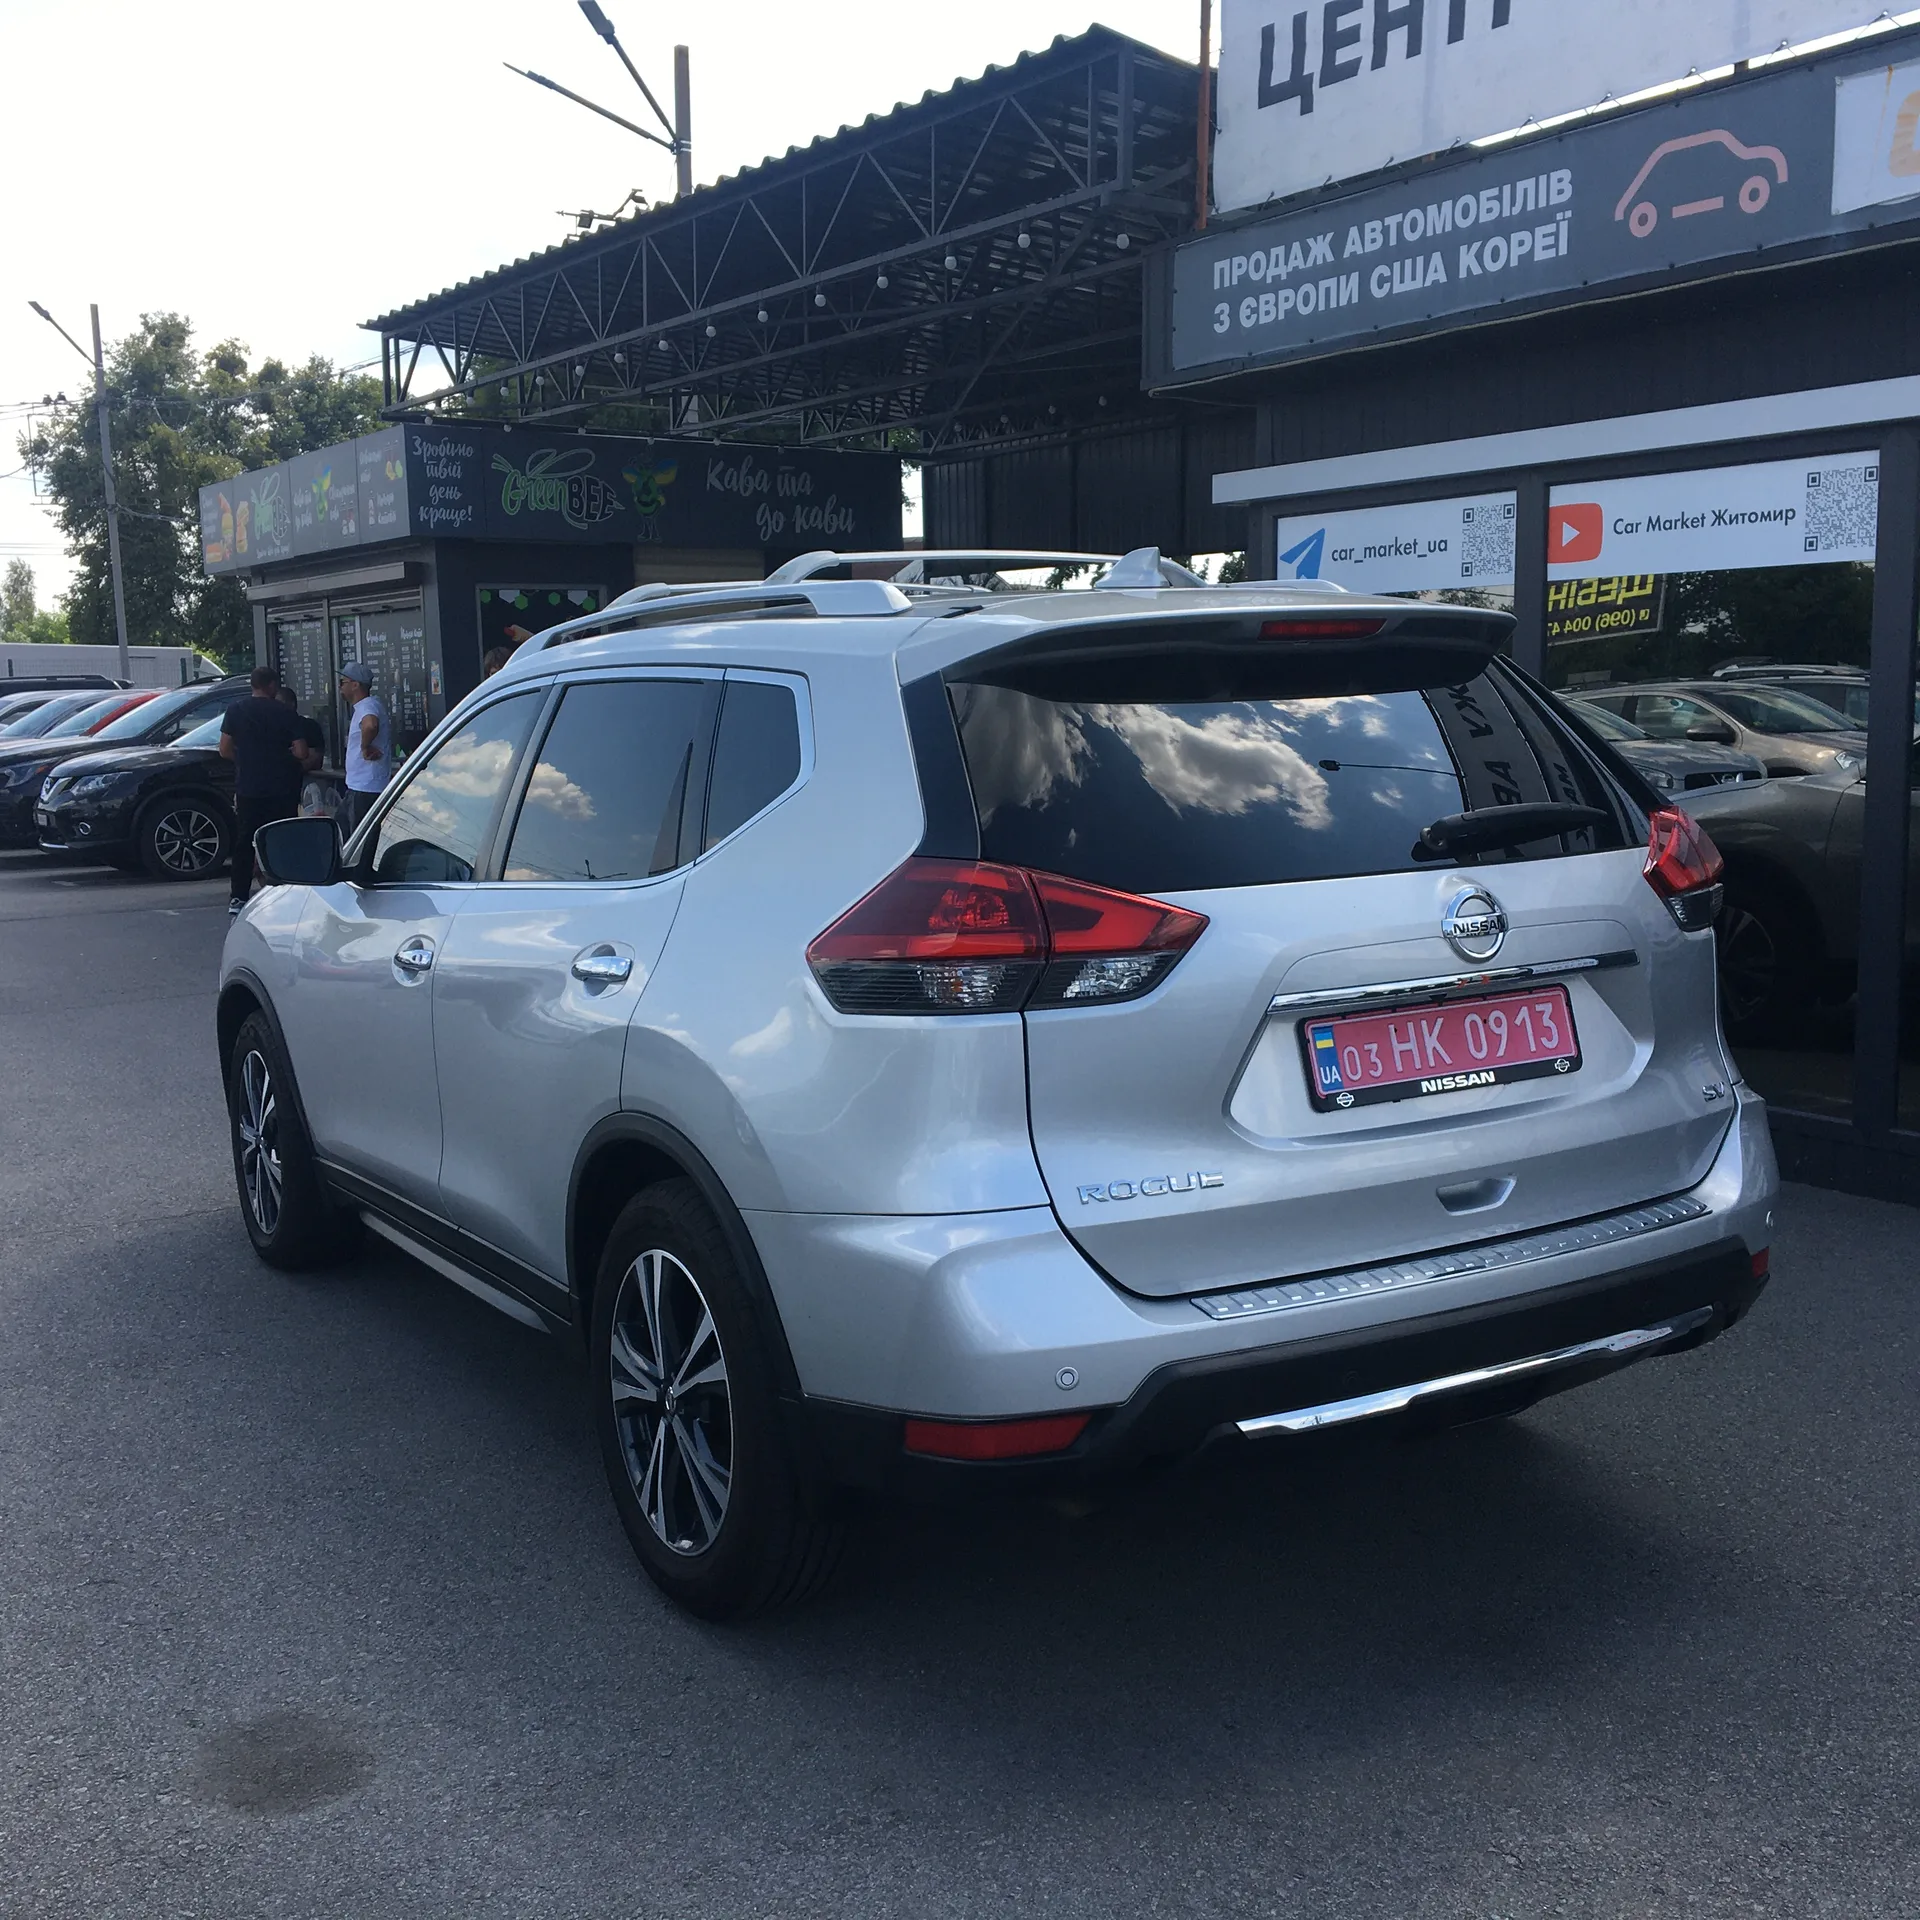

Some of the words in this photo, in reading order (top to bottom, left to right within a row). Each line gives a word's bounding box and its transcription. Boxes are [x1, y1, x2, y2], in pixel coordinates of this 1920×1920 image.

[1213, 231, 1335, 291] ПРОДАЖ
[1343, 168, 1574, 259] АВТОМОБІЛІВ
[1213, 301, 1231, 334] З
[1239, 271, 1360, 329] ЄВРОПИ
[1370, 250, 1448, 299] США
[1459, 210, 1573, 280] КОРЕЇ
[429, 484, 462, 505] день
[418, 505, 473, 529] краще!
[1613, 518, 1642, 536] Car
[1646, 512, 1707, 533] Market
[1710, 507, 1797, 527] Житомир
[1331, 536, 1448, 564] car_market_ua
[1453, 919, 1506, 934] NISSAN
[1319, 1065, 1342, 1085] UA
[1342, 1042, 1383, 1081] 03
[1388, 1016, 1453, 1073] HK
[1463, 1001, 1560, 1061] 0913
[1420, 1070, 1496, 1093] NISSAN
[1702, 1081, 1725, 1103] SV
[1076, 1170, 1225, 1205] ROGUE
